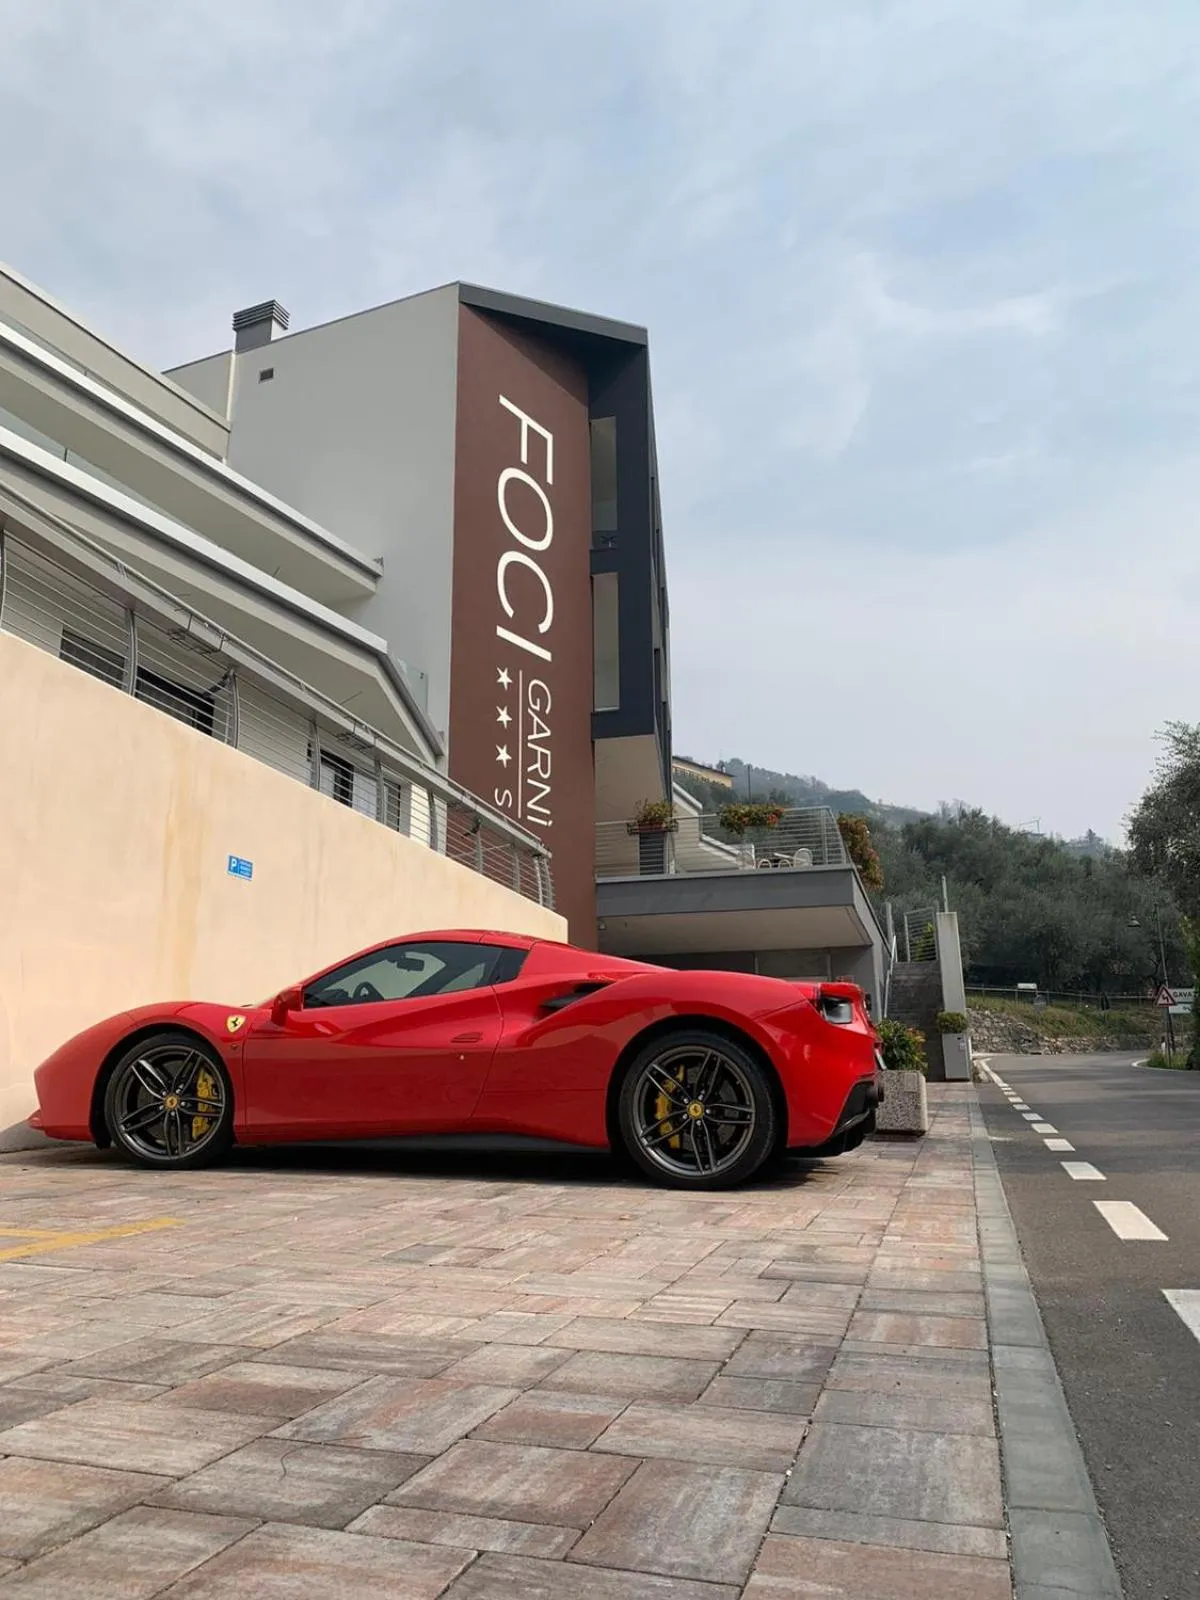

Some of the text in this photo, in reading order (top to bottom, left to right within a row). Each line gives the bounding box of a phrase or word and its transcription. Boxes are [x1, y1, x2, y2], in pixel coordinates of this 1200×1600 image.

[497, 394, 554, 662] FOCI
[494, 788, 513, 808] S
[230, 858, 238, 872] P
